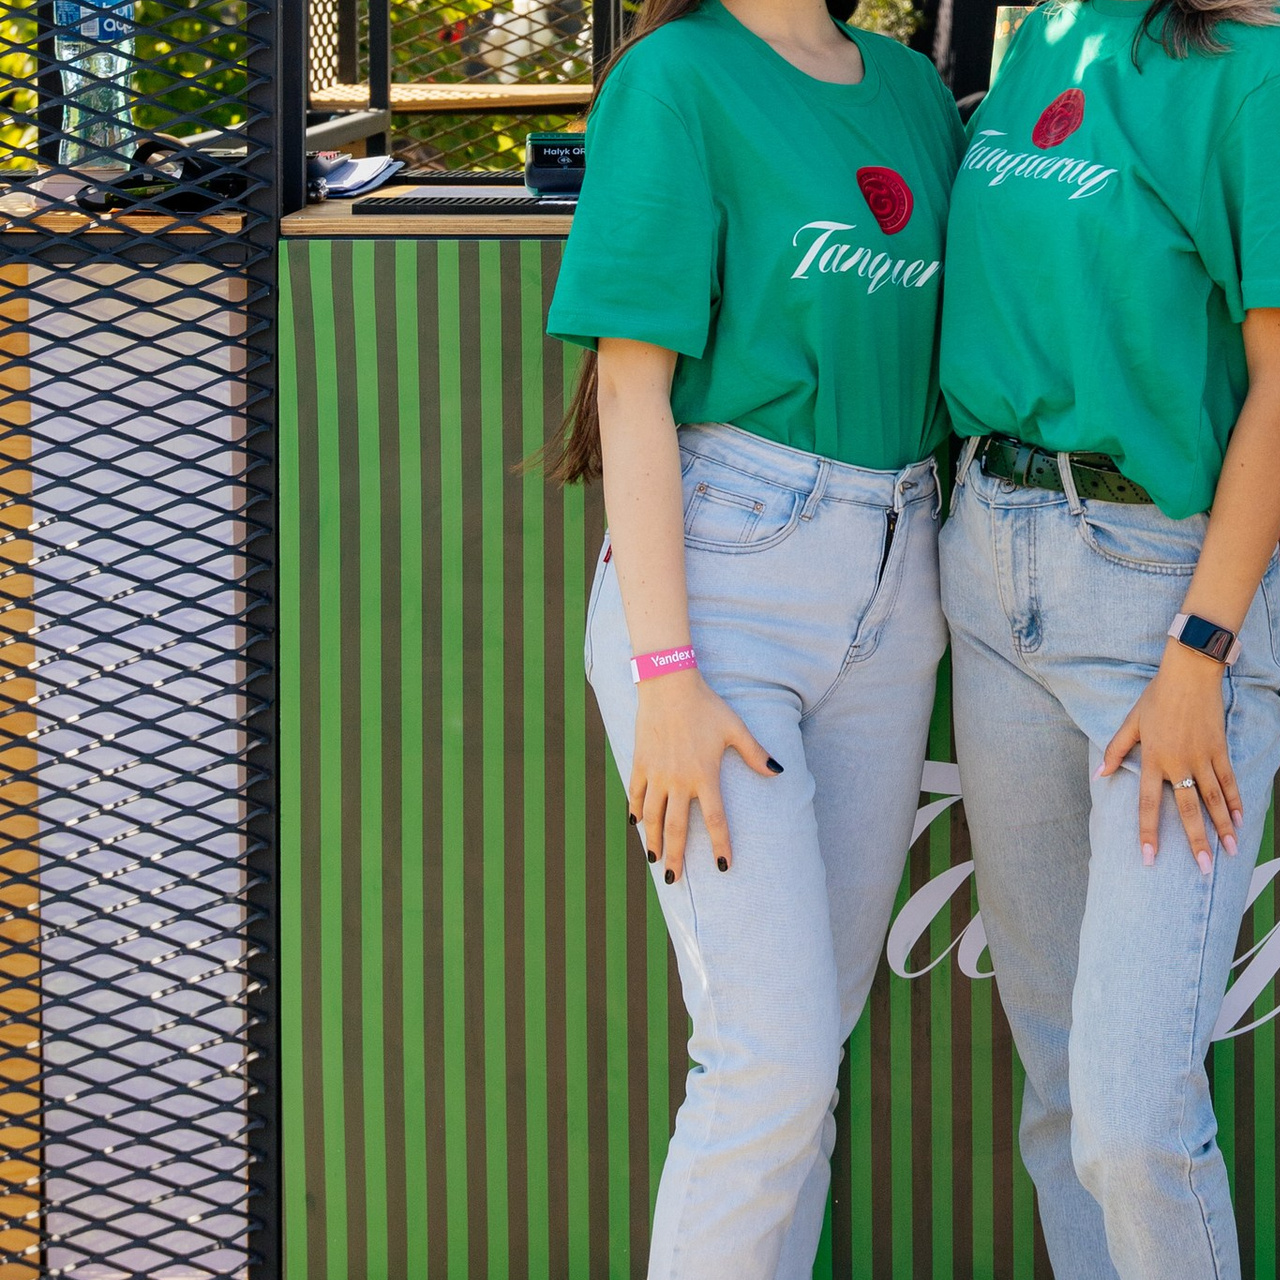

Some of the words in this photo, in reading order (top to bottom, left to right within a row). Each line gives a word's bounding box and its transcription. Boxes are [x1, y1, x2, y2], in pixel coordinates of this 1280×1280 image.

[543, 147, 570, 156] Halyk
[572, 147, 585, 156] QR
[960, 129, 1119, 200] Tanqueray
[791, 221, 943, 295] Tanquer
[651, 650, 690, 667] Yandex
